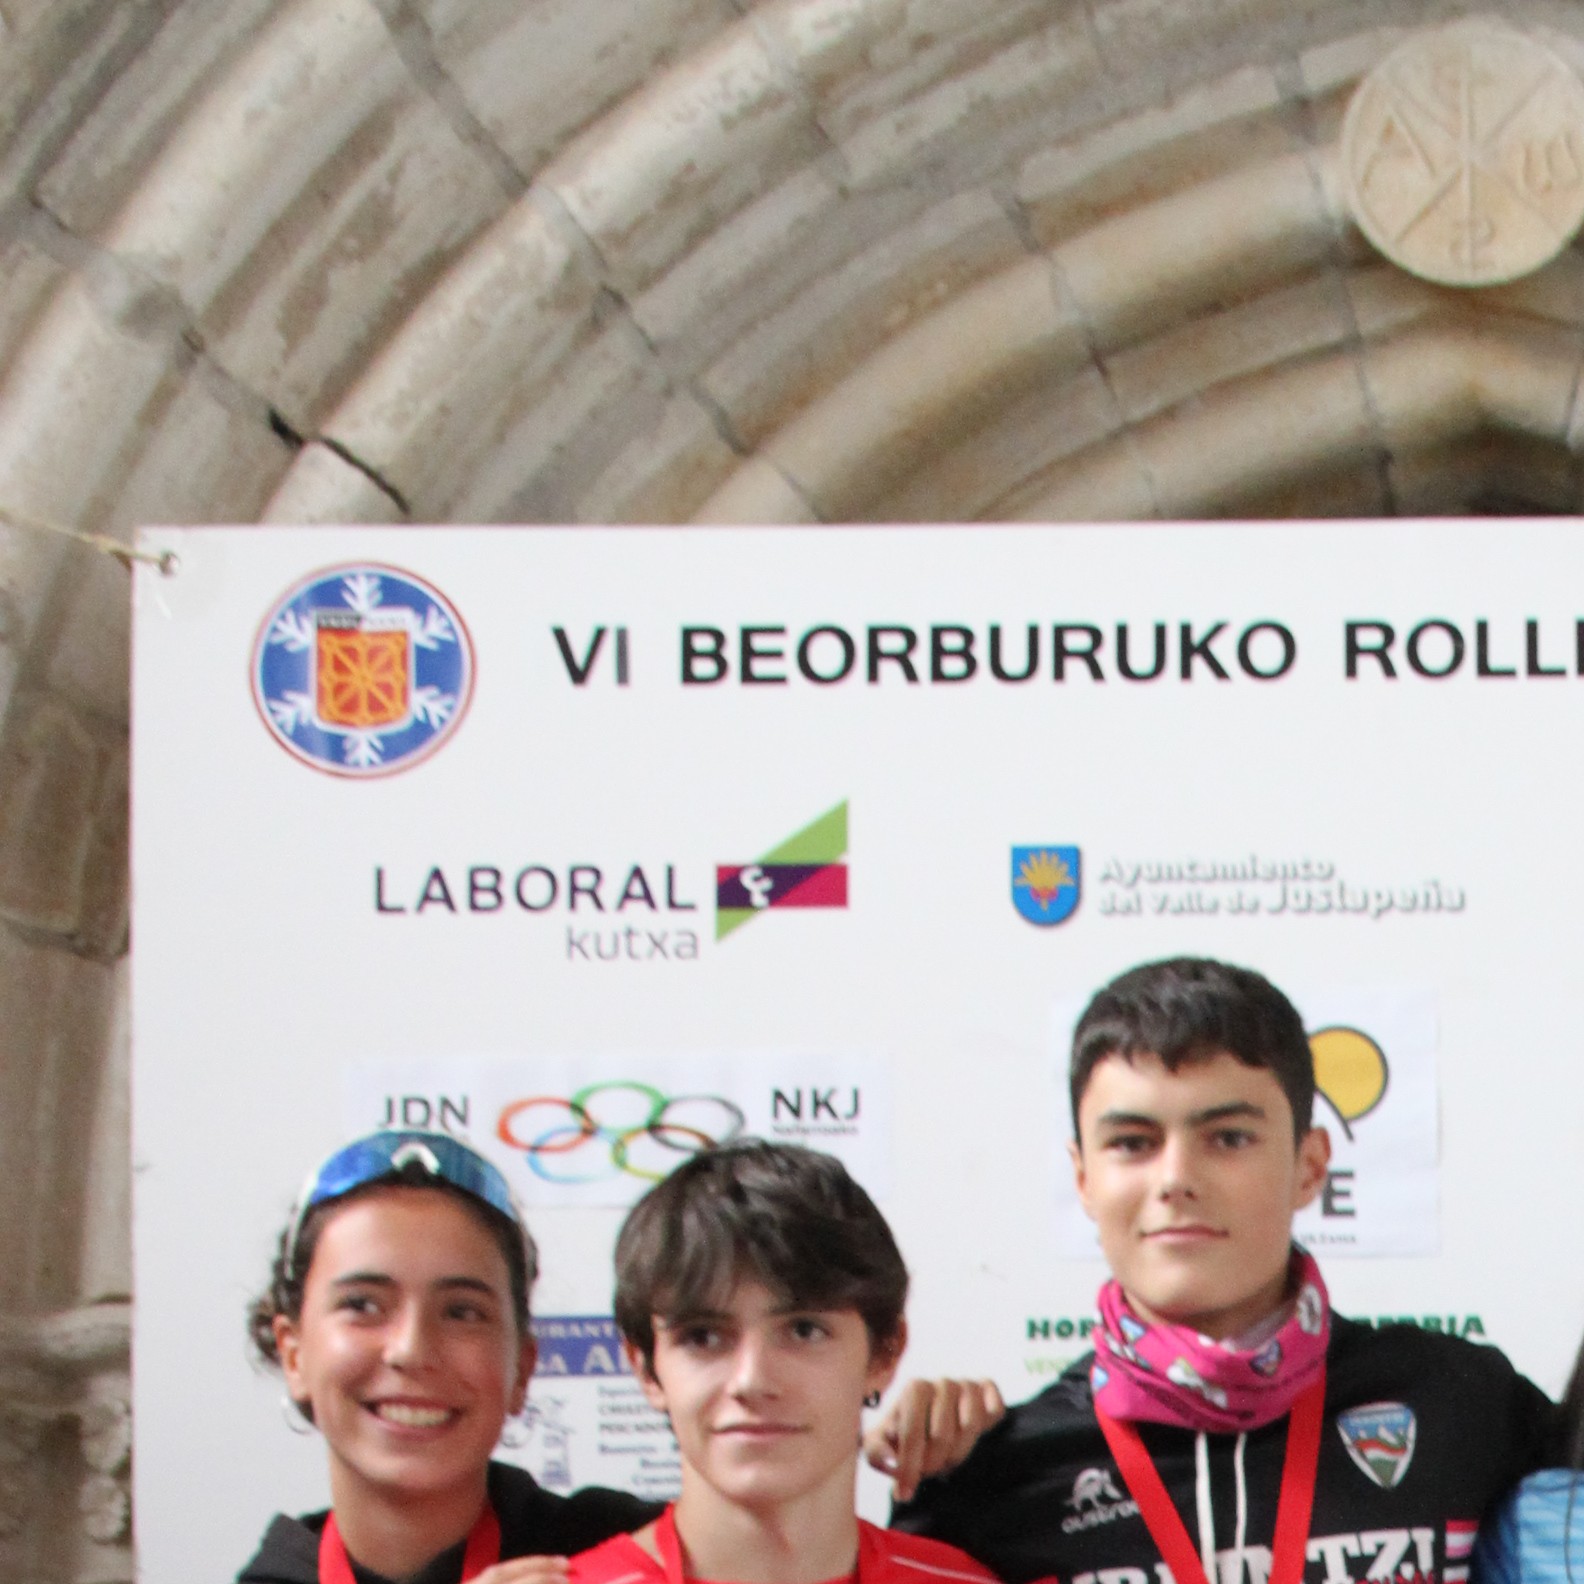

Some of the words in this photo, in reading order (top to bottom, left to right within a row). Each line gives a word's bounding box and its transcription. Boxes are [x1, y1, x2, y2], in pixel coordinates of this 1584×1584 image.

[552, 624, 629, 687] VI
[680, 620, 1297, 686] BEORBURUKO
[374, 866, 698, 913] LABORAL
[567, 925, 699, 962] kutxa
[378, 1094, 471, 1129] JDN
[772, 1087, 862, 1120] NKJ
